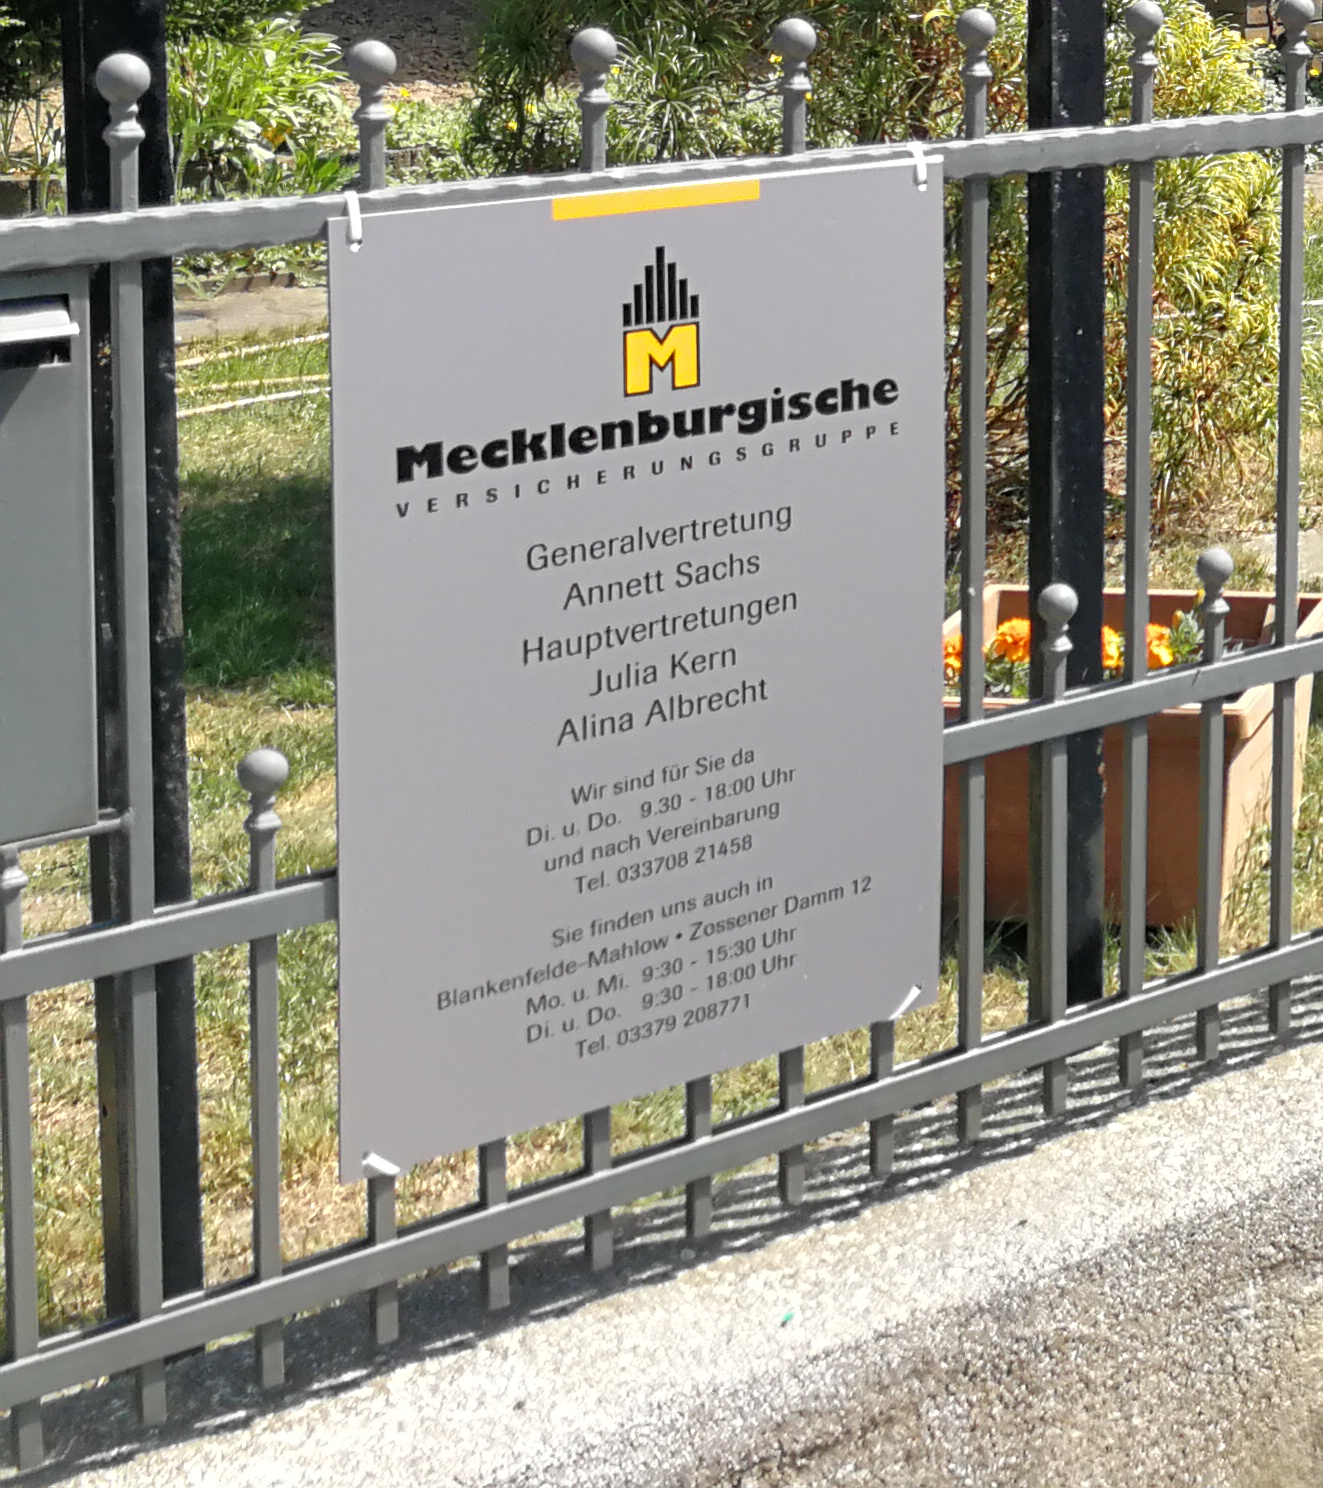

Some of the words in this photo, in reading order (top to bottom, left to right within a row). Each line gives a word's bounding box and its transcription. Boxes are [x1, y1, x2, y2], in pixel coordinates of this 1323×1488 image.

[396, 377, 900, 484] Mecklenburgische
[396, 420, 901, 518] VERSICHERUNGSGRUPPE
[526, 505, 792, 571] Generalvertretung
[562, 570, 665, 610] Annett
[674, 553, 760, 588] Sachs
[522, 592, 798, 666] Hauptvertretungen
[589, 662, 658, 696] Julia
[670, 647, 736, 679] Kern
[557, 712, 634, 746] Alina
[645, 678, 768, 726] Albrecht
[526, 828, 554, 846] Di.
[562, 824, 580, 837] u.
[588, 814, 622, 832] Do.
[640, 794, 682, 818] 9.30
[705, 775, 755, 802] 18:00
[760, 766, 796, 788] Uhr
[571, 782, 606, 806] Wir
[612, 770, 654, 796] sind
[661, 764, 690, 784] für
[695, 755, 725, 776] Sie
[730, 748, 755, 767] da
[544, 848, 584, 872] und
[590, 834, 640, 860] nach
[647, 801, 780, 846] Vereinbarung
[575, 874, 610, 894] Tel.
[616, 851, 688, 884] 033708
[694, 834, 753, 864] 21458
[436, 935, 669, 1011] Blankenfelde-Mahlow
[689, 902, 778, 941] Zossener
[784, 886, 845, 915] Damm
[851, 875, 872, 894] 12
[551, 926, 583, 947] Sie
[589, 909, 655, 939] finden
[660, 897, 697, 919] uns
[703, 881, 751, 908] auch
[756, 875, 773, 893] in
[526, 994, 566, 1015] Mo.
[572, 987, 590, 1001] u.
[598, 975, 630, 996] Mi.
[642, 957, 683, 983] 9:30
[706, 937, 756, 965] 15:30
[762, 926, 797, 951] Uhr
[526, 1023, 555, 1043] Di.
[562, 1018, 580, 1032] u.
[587, 1007, 622, 1025] Do.
[642, 984, 683, 1010] 9:30
[706, 965, 756, 992] 18:00
[762, 952, 797, 977] Uhr
[575, 1039, 610, 1058] Tel.
[616, 1016, 676, 1046] 03379
[683, 992, 751, 1028] 208771
